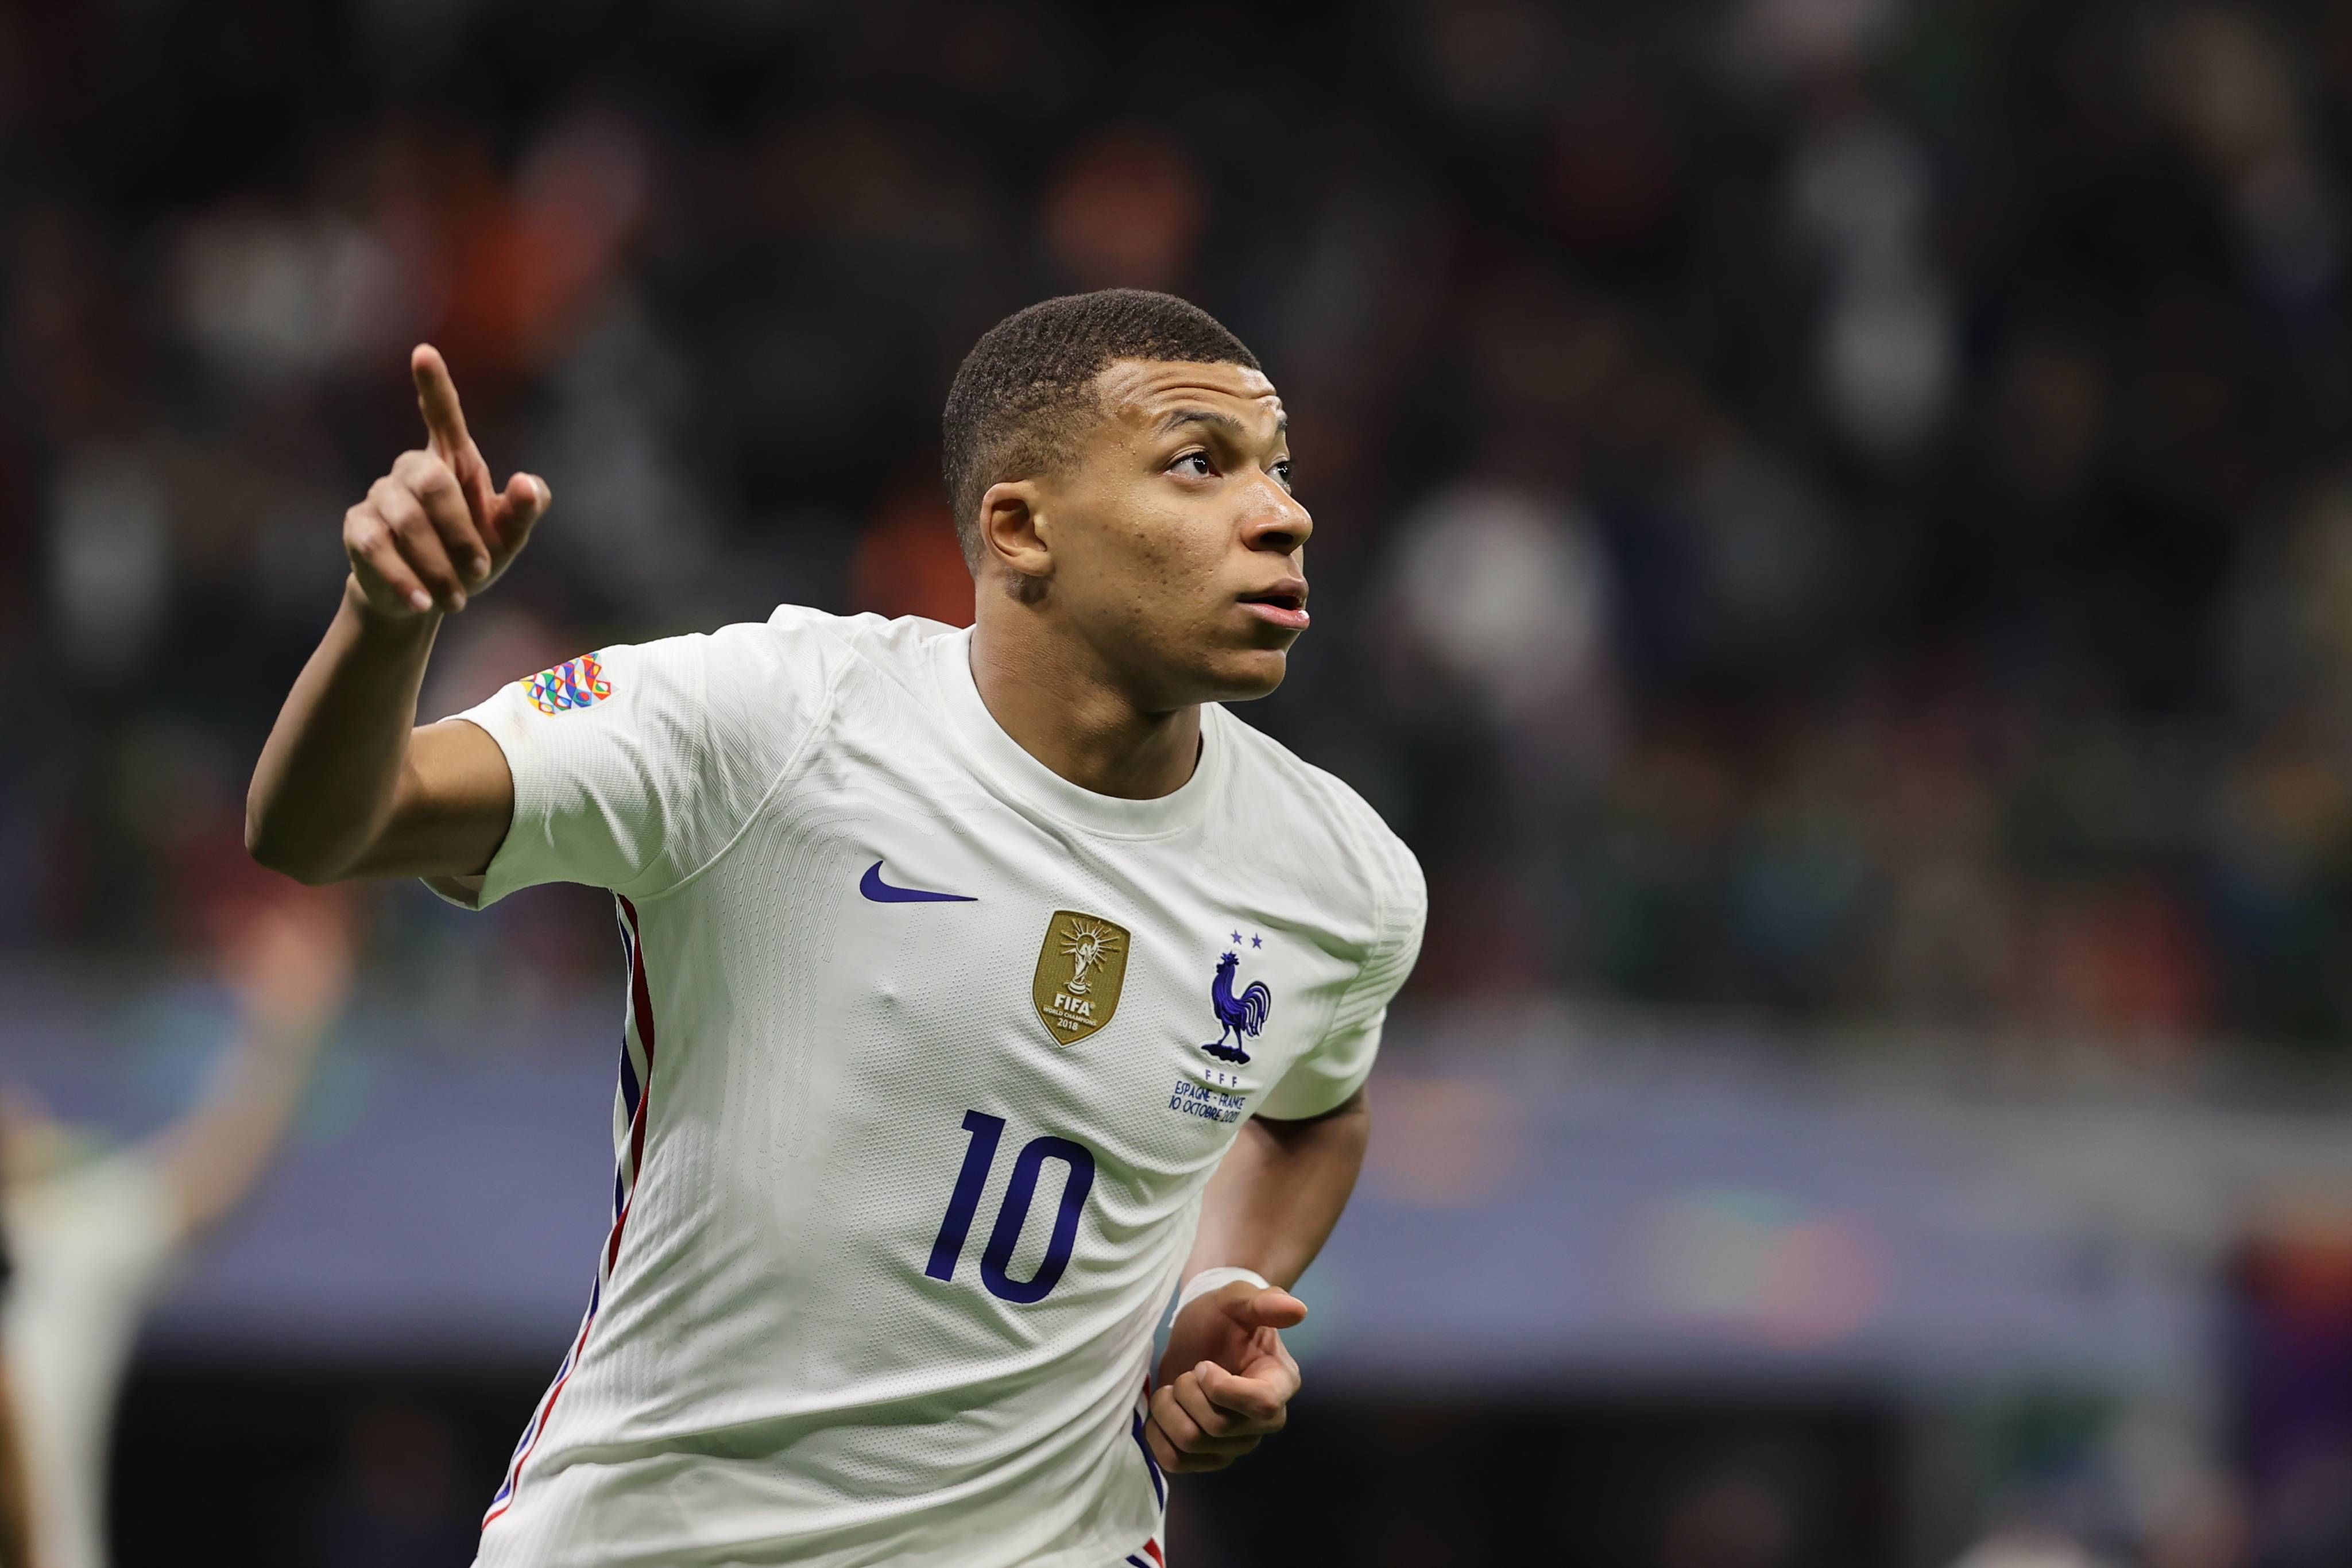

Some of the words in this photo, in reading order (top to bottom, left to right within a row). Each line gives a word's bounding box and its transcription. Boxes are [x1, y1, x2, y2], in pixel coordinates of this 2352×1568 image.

[1043, 1006, 1063, 1016] WORLD
[1063, 1012, 1097, 1026] CHAMPIONS
[1057, 1018, 1078, 1031] 2018
[1169, 1095, 1181, 1109] 10
[1183, 1100, 1223, 1120] OCTOBRE
[1175, 1081, 1213, 1102] ESPAGNE
[1218, 1093, 1245, 1109] FRANCE
[924, 1109, 1095, 1304] 10
